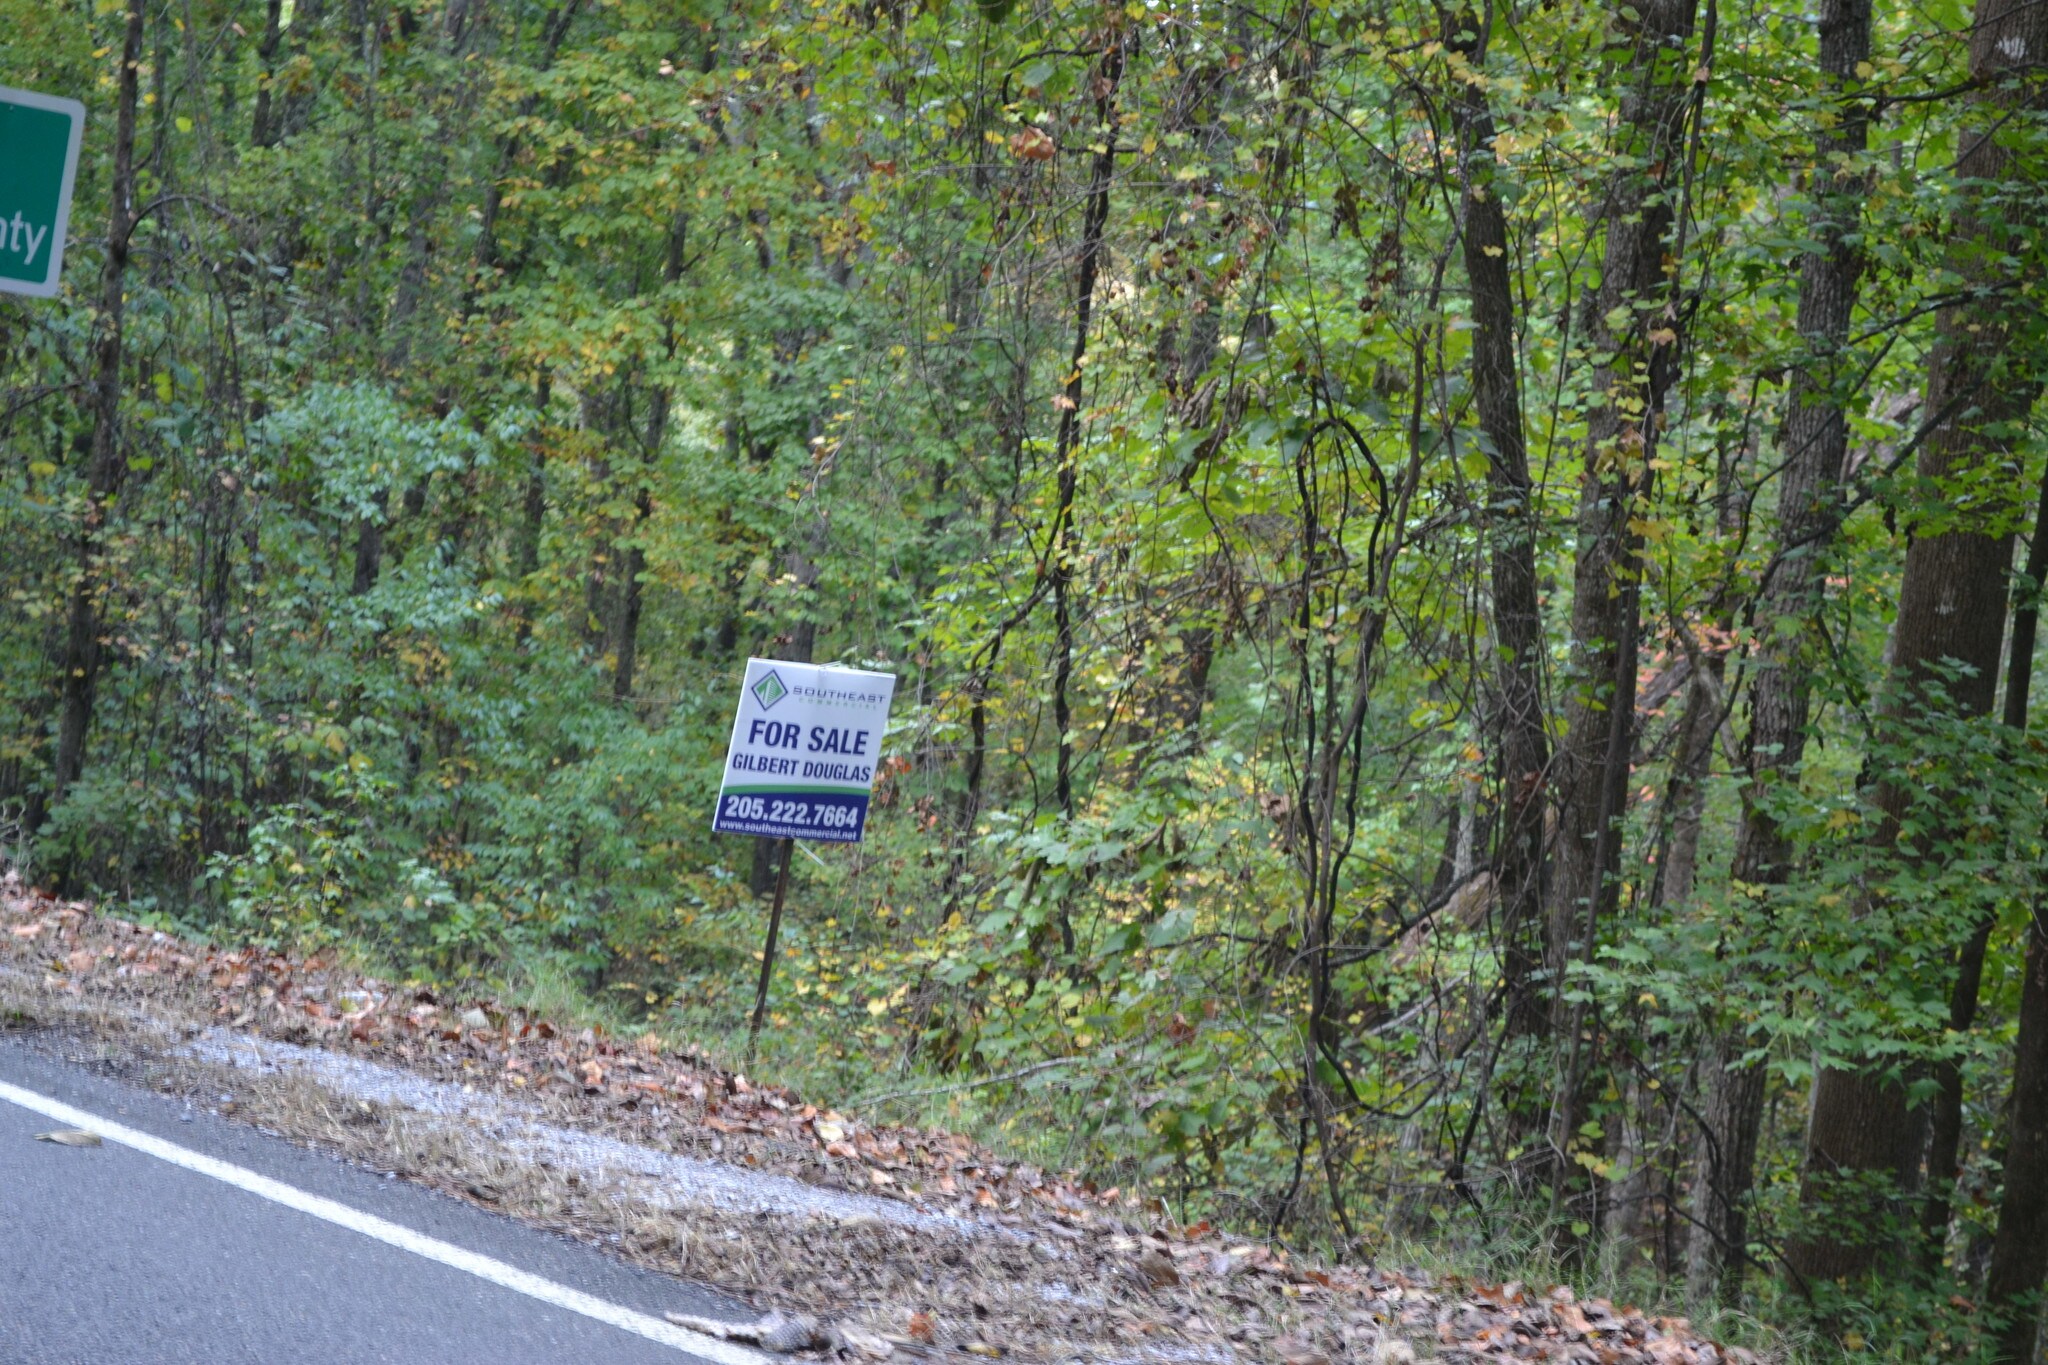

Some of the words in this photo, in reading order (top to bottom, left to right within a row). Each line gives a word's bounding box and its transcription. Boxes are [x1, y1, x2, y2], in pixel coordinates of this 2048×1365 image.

[793, 685, 886, 704] SOUTHEAST
[748, 719, 800, 749] FOR
[808, 726, 869, 755] SALE
[732, 753, 799, 776] GILBERT
[802, 760, 871, 782] DOUGLAS
[725, 795, 858, 828] 205.222.7664
[719, 820, 857, 841] www.southeastcommercial.net
